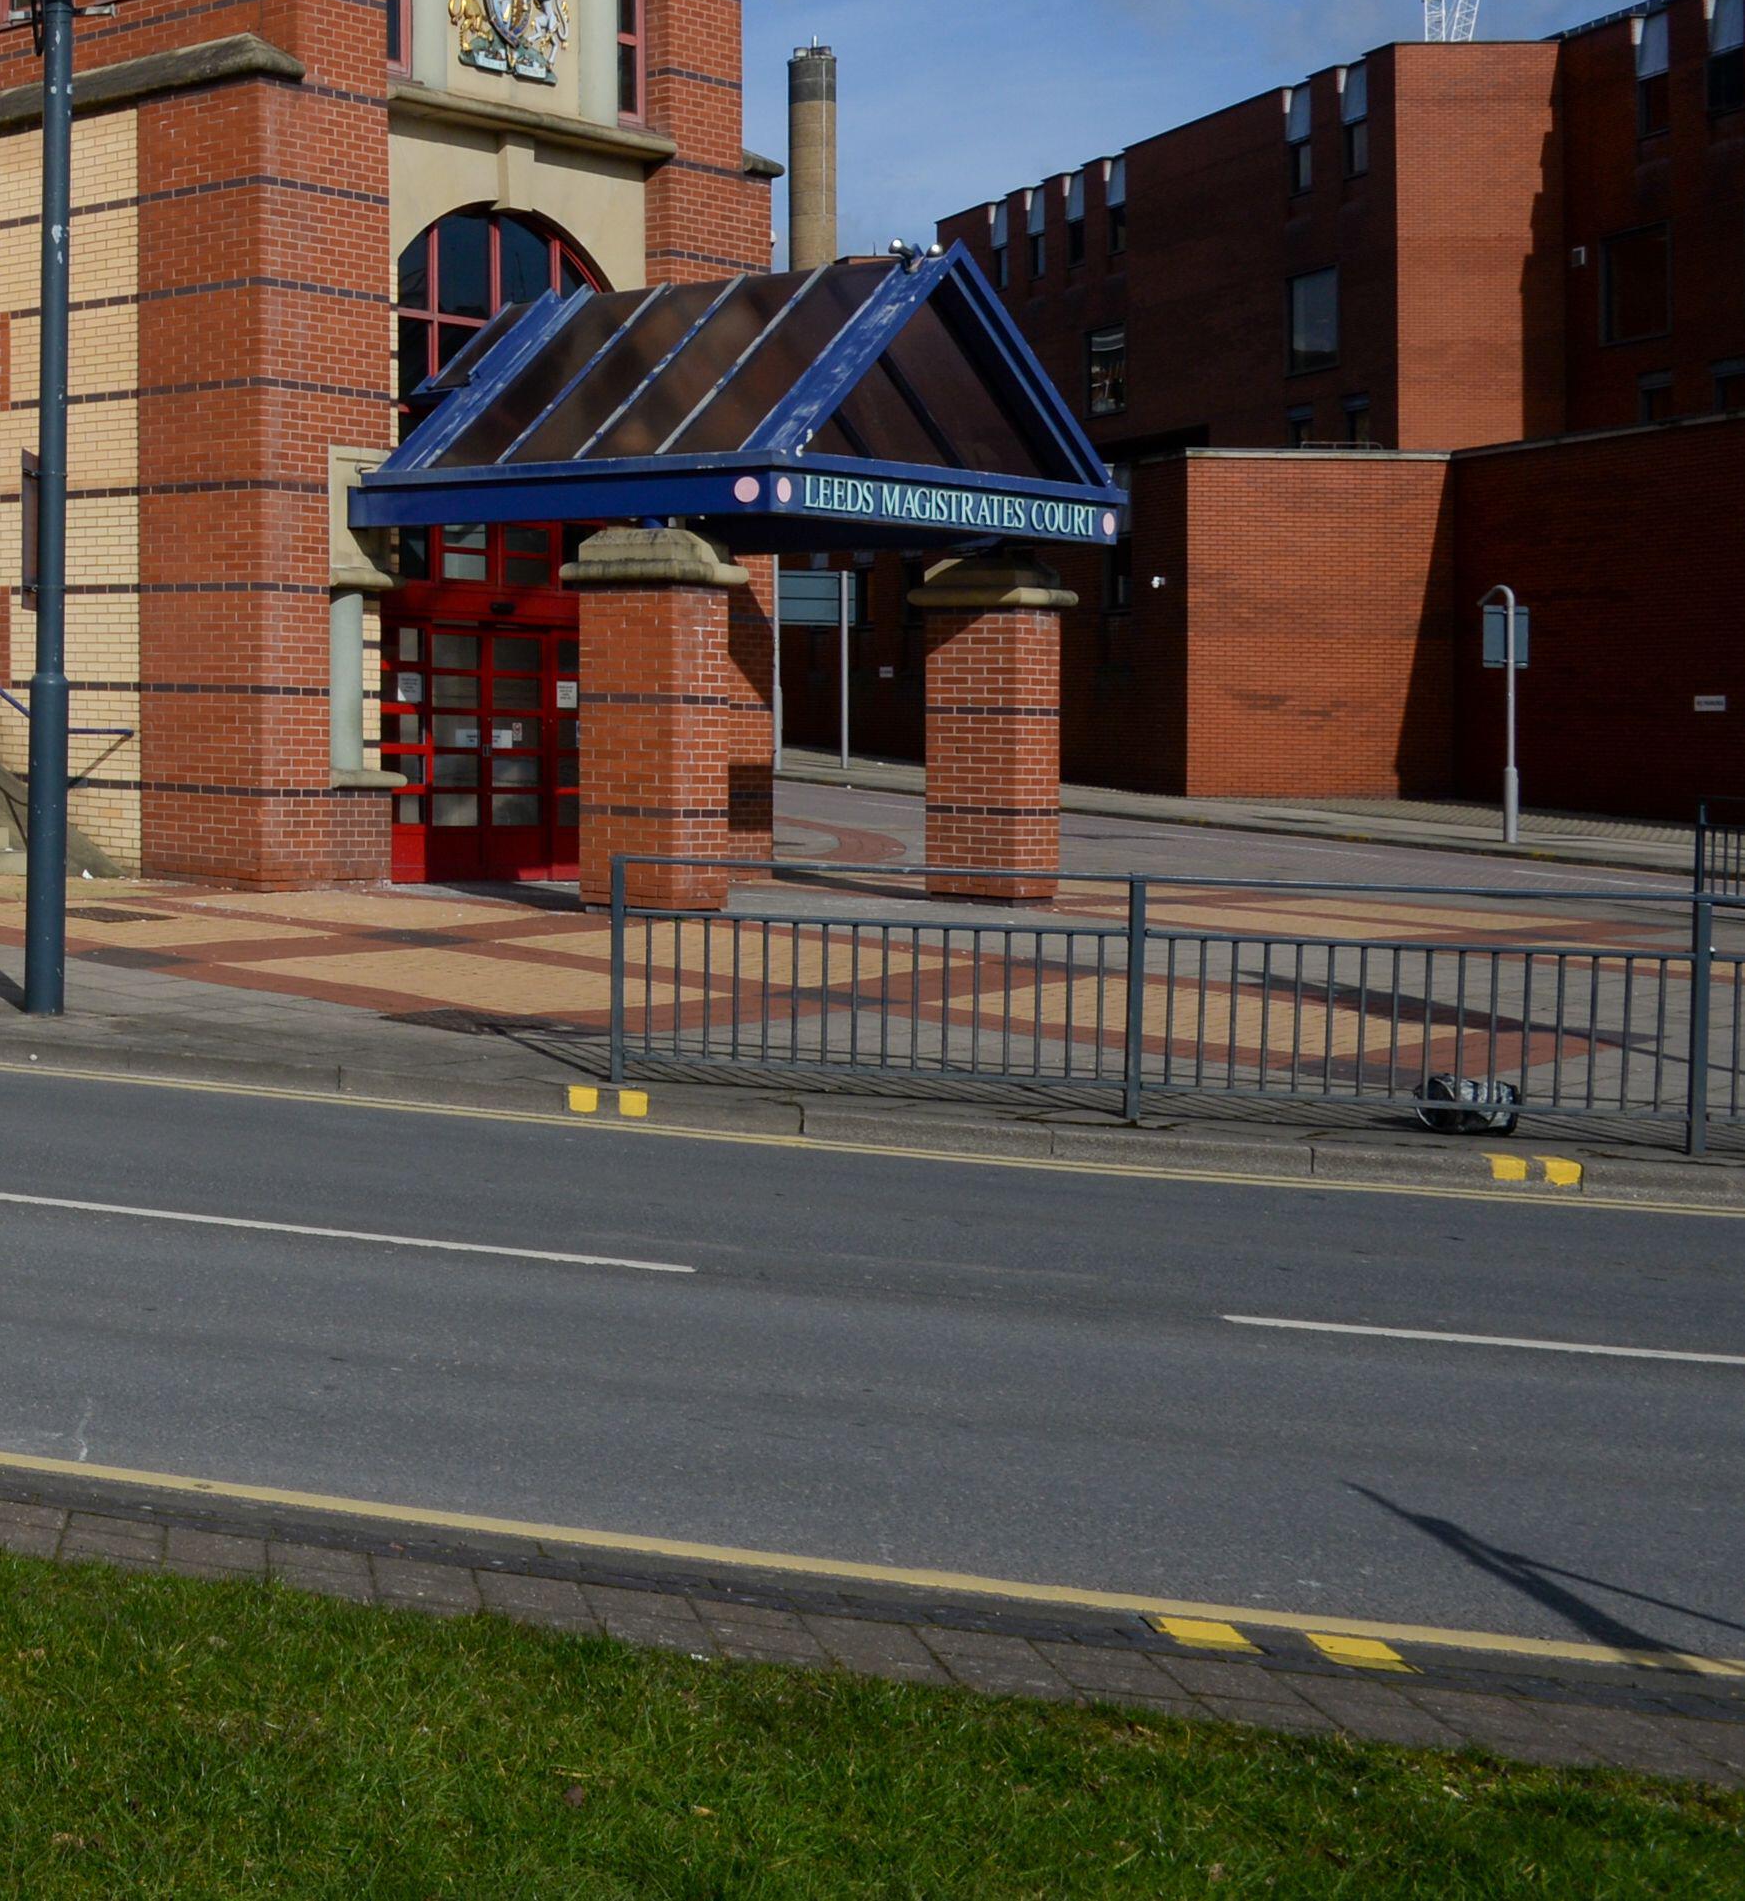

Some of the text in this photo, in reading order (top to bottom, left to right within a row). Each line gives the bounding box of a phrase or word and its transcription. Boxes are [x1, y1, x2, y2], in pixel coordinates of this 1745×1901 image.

[803, 474, 1097, 537] LEEDS MAGISTRATES COURT
